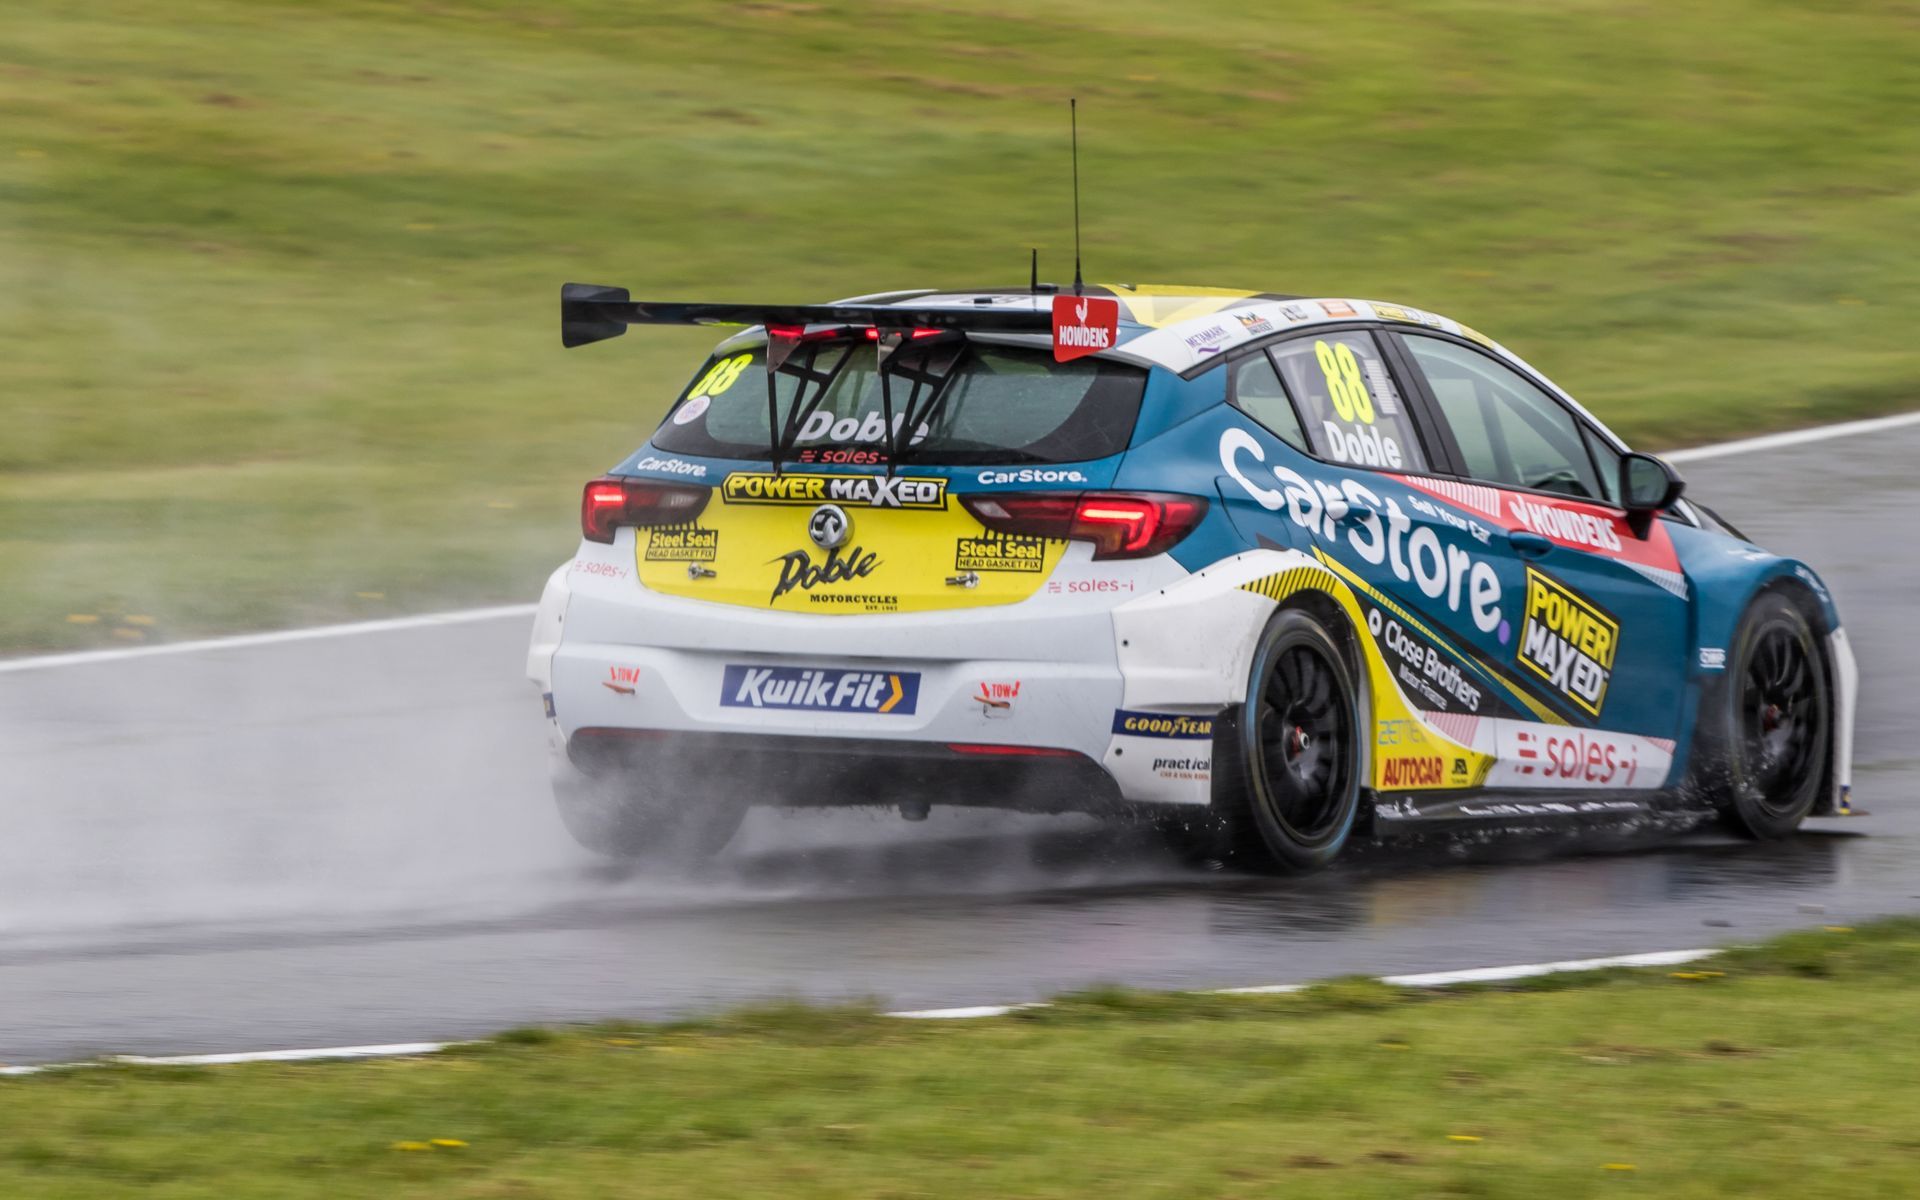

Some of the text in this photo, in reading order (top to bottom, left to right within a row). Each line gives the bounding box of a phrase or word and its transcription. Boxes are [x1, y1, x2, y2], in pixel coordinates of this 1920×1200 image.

[1059, 325, 1109, 348] HOWDENS
[1185, 324, 1226, 349] METAMARK
[687, 353, 754, 401] 88
[1314, 339, 1375, 425] 88
[1322, 420, 1402, 470] Doble
[977, 469, 1088, 485] CarStore.
[729, 475, 940, 507] POWER MAXED
[1407, 494, 1491, 545] Sell Your Car
[1526, 501, 1622, 553] HOWDENS
[651, 531, 717, 548] Steel Seal
[959, 540, 1043, 560] Steel Seal
[648, 549, 714, 560] HEAD GASKET FIX
[960, 558, 1039, 570] HEAD GASKET FIX
[583, 561, 629, 579] sales-i
[763, 546, 886, 606] Doble
[1068, 579, 1135, 593] sales-i
[810, 594, 898, 604] MOTORCYCLES
[1530, 579, 1612, 667] POWER
[1385, 619, 1482, 712] Close Brothers
[1523, 617, 1604, 702] MAXED
[992, 683, 1011, 698] TOW
[1124, 716, 1213, 737] GOODYEAR
[1153, 757, 1211, 771] practical
[1383, 756, 1443, 786] AUTOCAR
[1543, 733, 1638, 786] sales-i
